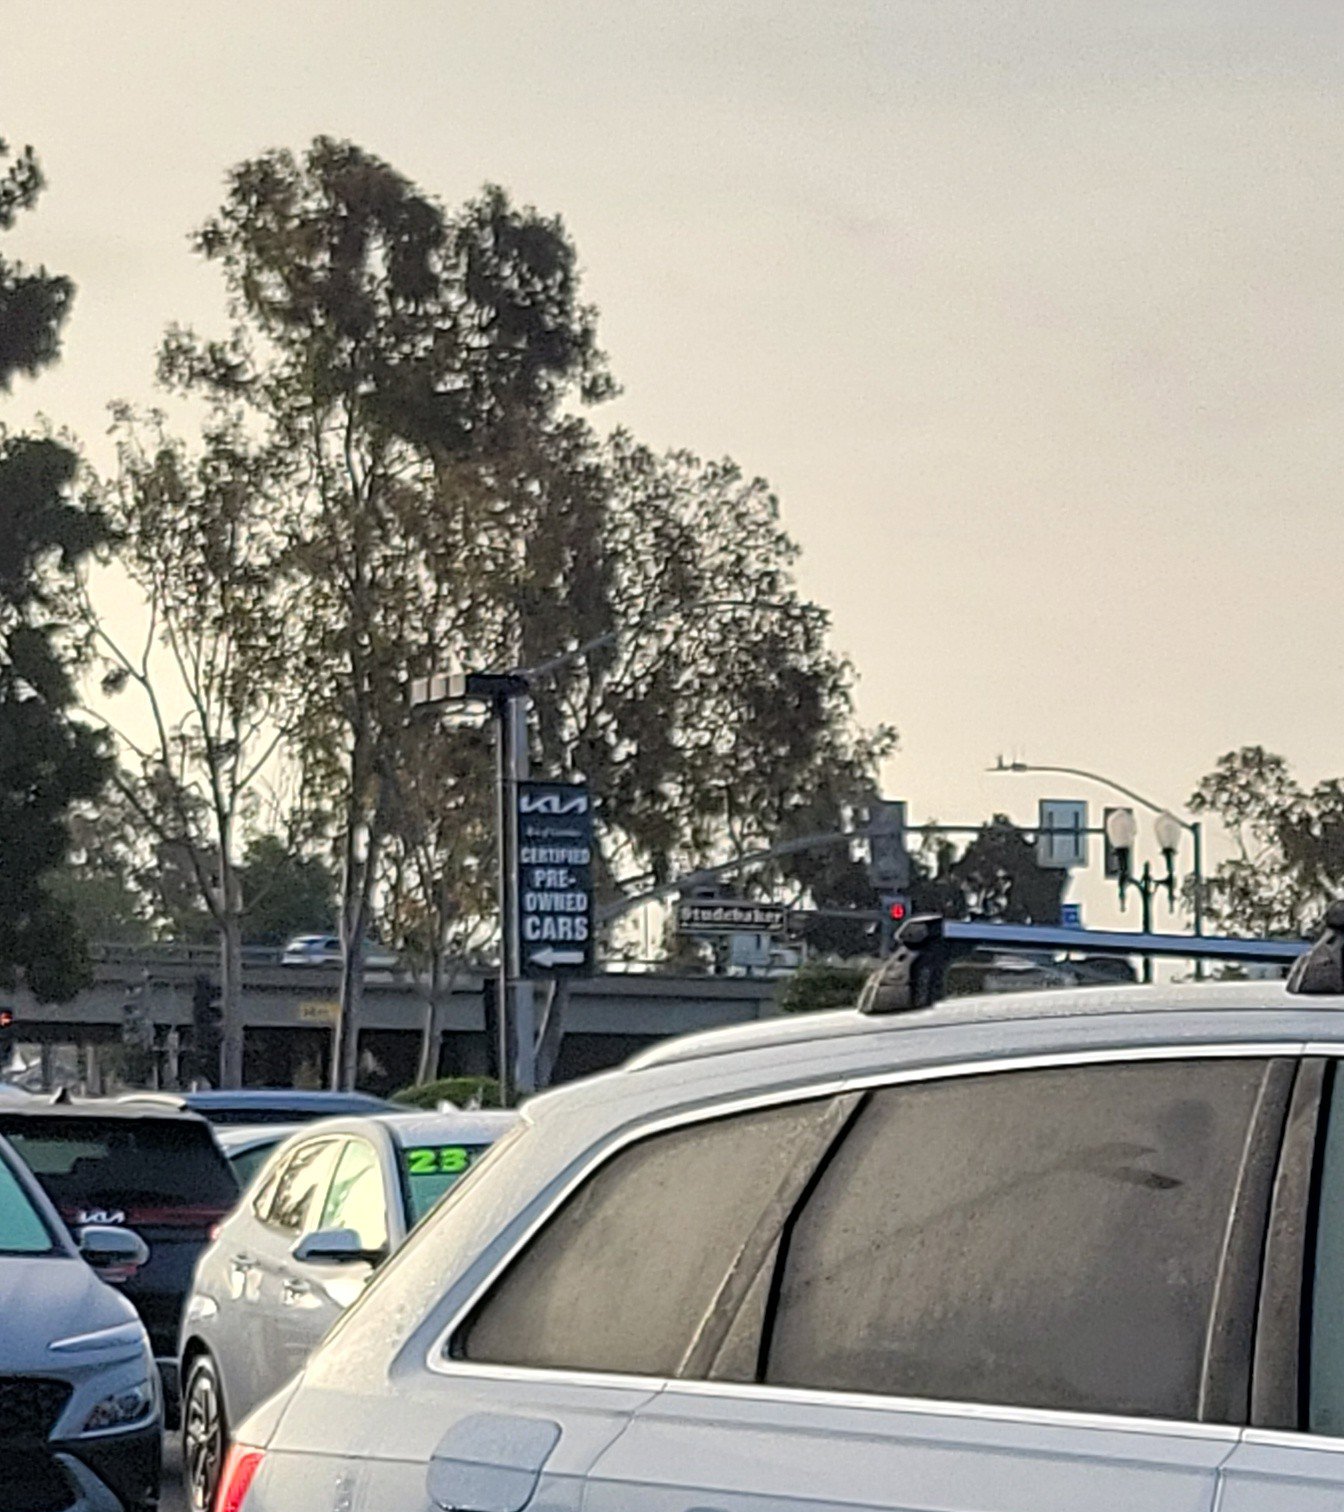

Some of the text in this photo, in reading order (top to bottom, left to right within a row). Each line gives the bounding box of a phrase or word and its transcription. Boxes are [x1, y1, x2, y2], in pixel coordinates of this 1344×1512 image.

[519, 795, 588, 814] KIA
[521, 848, 591, 865] CERTIFIED
[534, 869, 577, 889] PRE-
[524, 892, 588, 912] OWNED
[525, 915, 588, 941] CARS
[408, 1148, 468, 1174] 23
[79, 1210, 126, 1224] KIA
